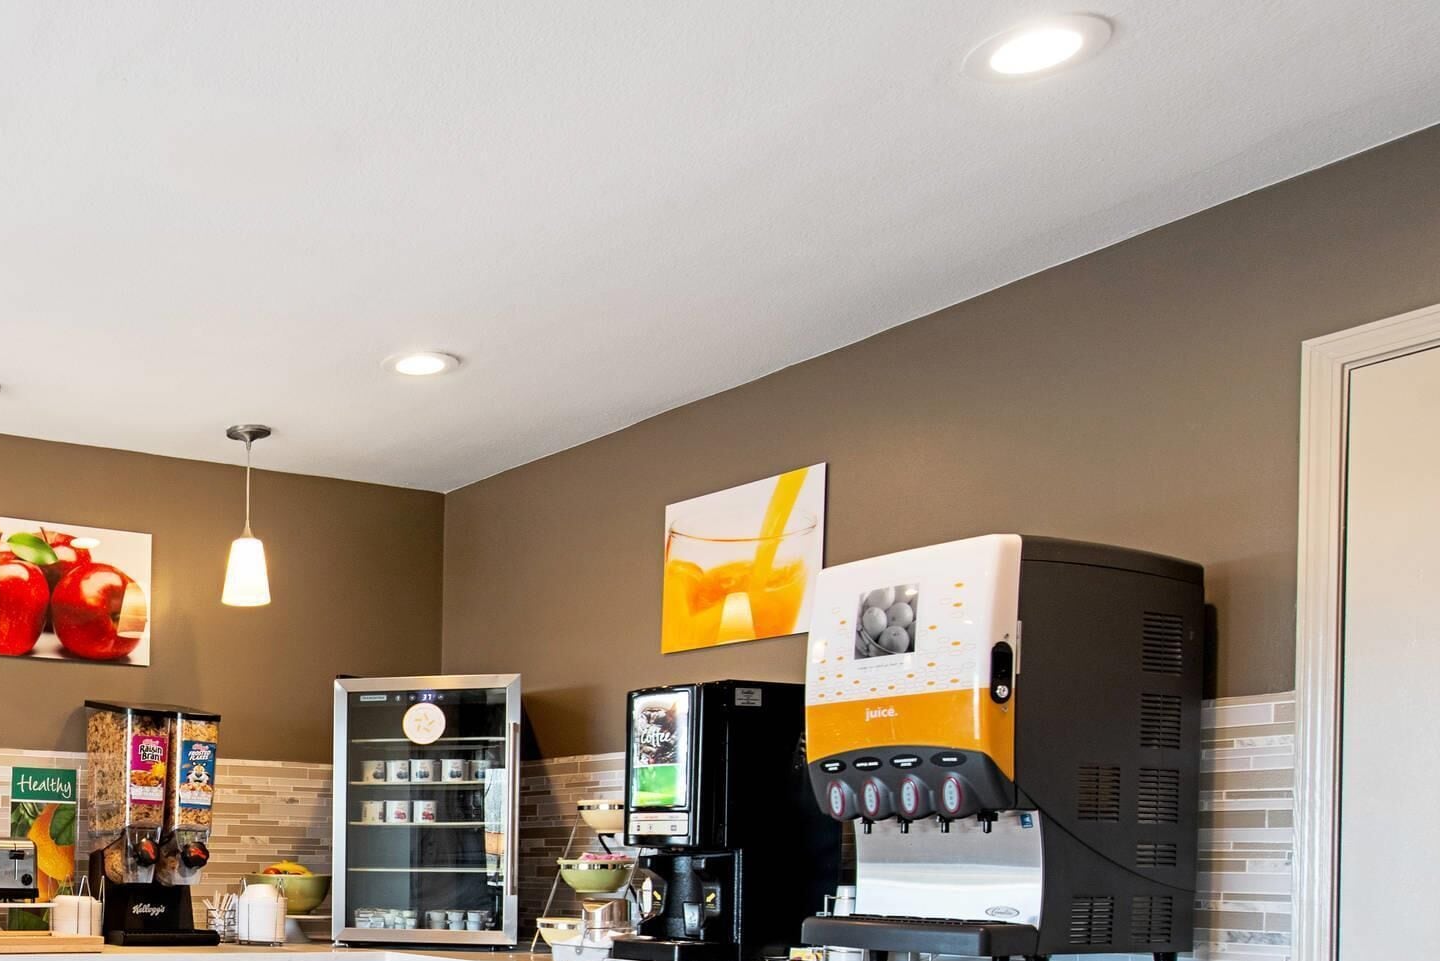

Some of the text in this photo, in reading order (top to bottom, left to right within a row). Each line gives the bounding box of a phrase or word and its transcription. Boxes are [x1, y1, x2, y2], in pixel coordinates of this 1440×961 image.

[865, 707, 899, 722] juice.
[640, 726, 671, 747] Coffee
[138, 743, 163, 756] Raisin
[141, 752, 160, 762] Bran
[16, 774, 72, 799] Healthy
[132, 903, 165, 916] Kellogg's
